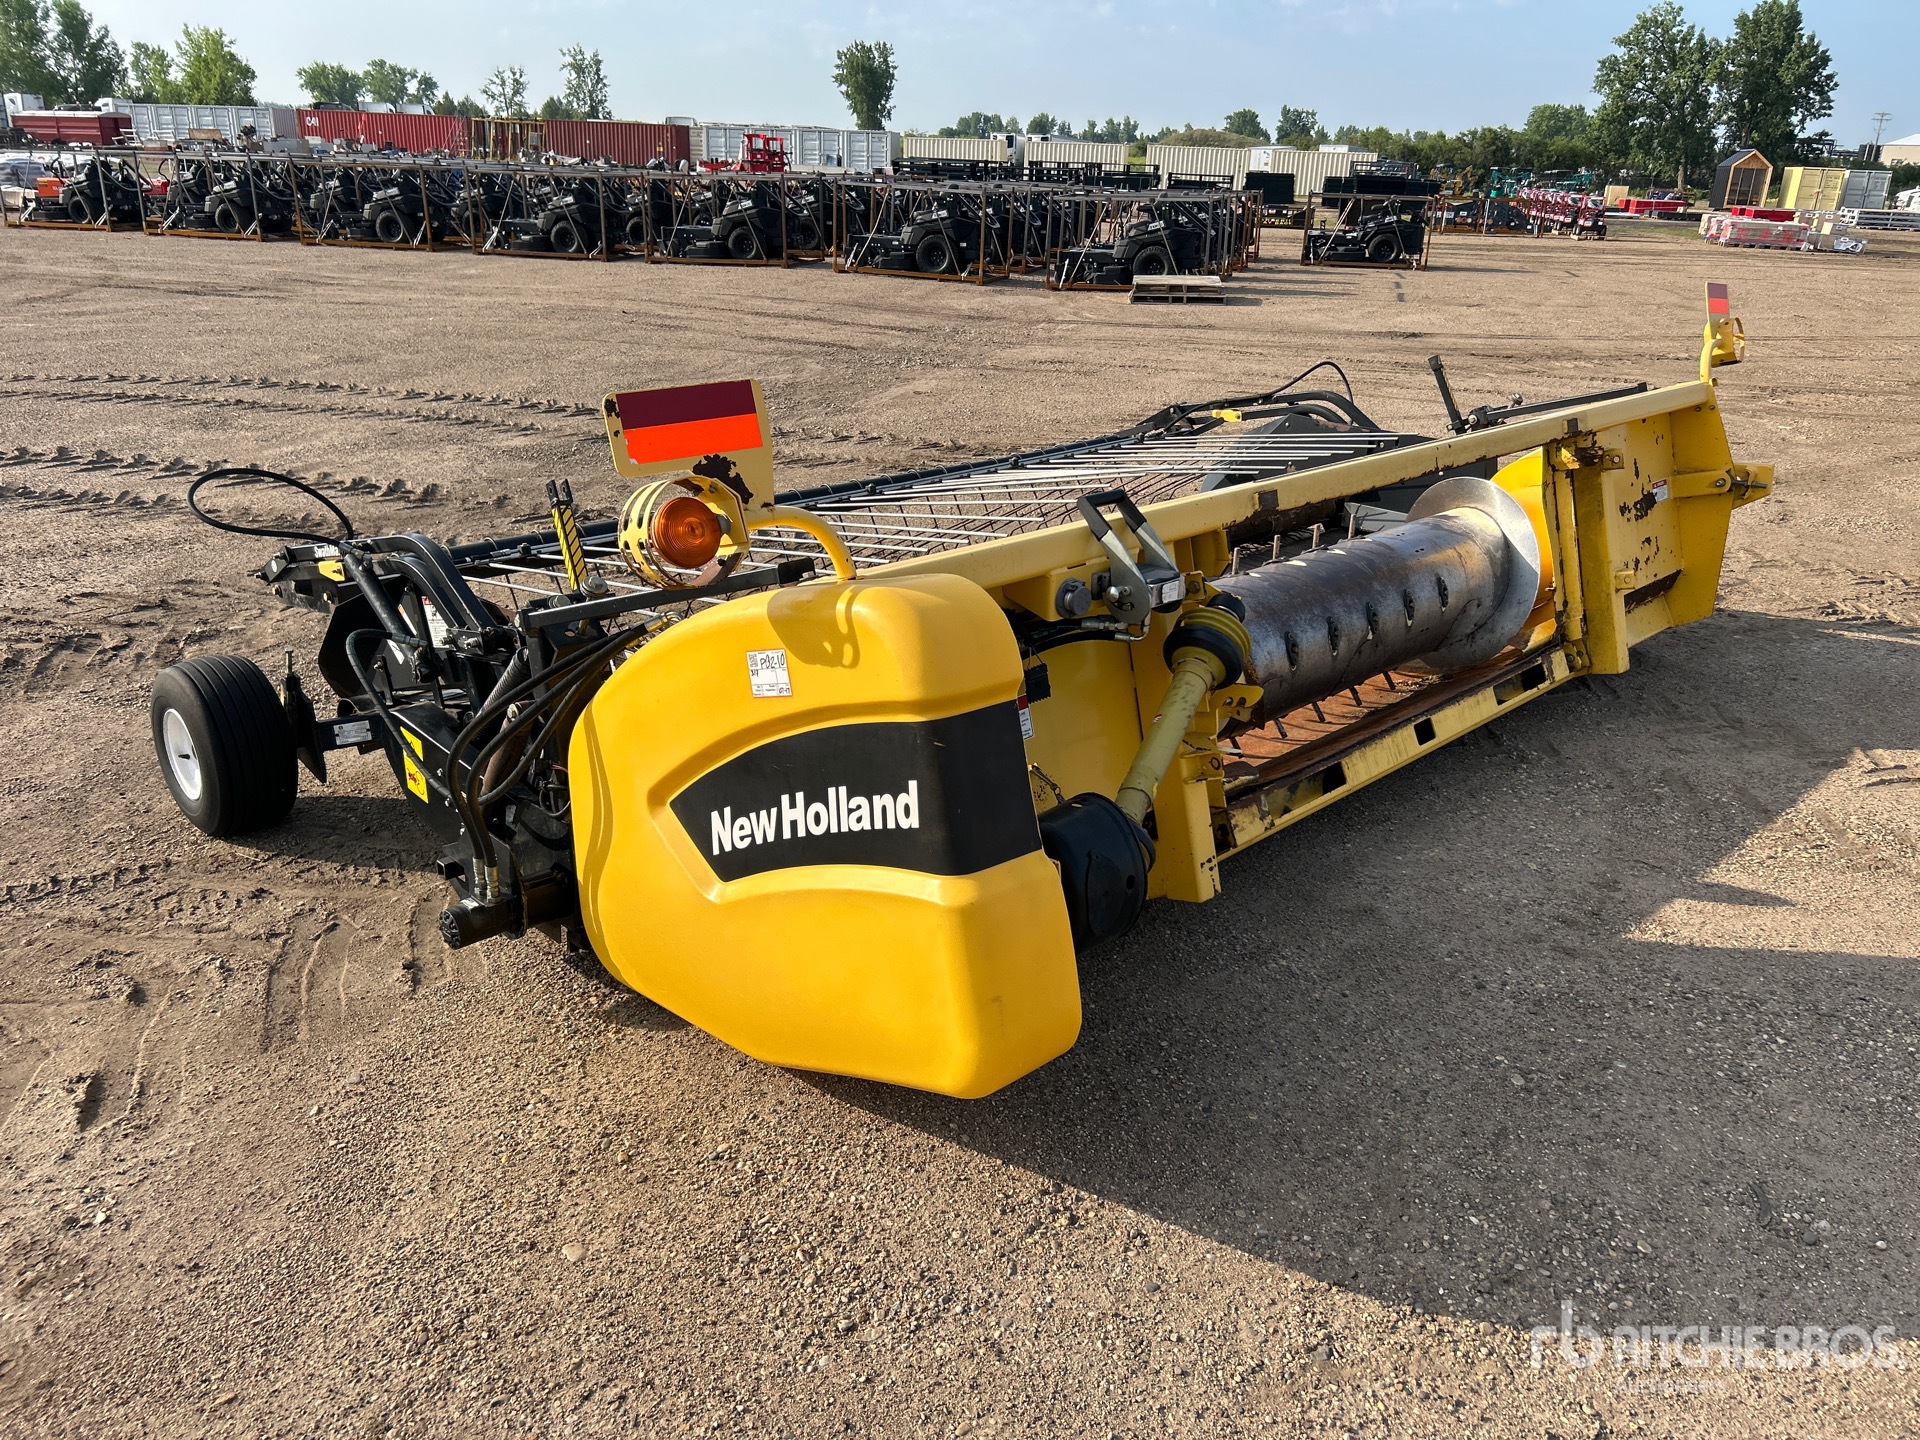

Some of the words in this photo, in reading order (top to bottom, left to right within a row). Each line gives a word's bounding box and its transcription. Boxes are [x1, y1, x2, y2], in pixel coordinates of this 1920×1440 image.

[306, 116, 319, 126] CAI
[314, 544, 340, 558] SwathMa
[711, 806, 777, 856] New
[781, 780, 920, 840] Holland
